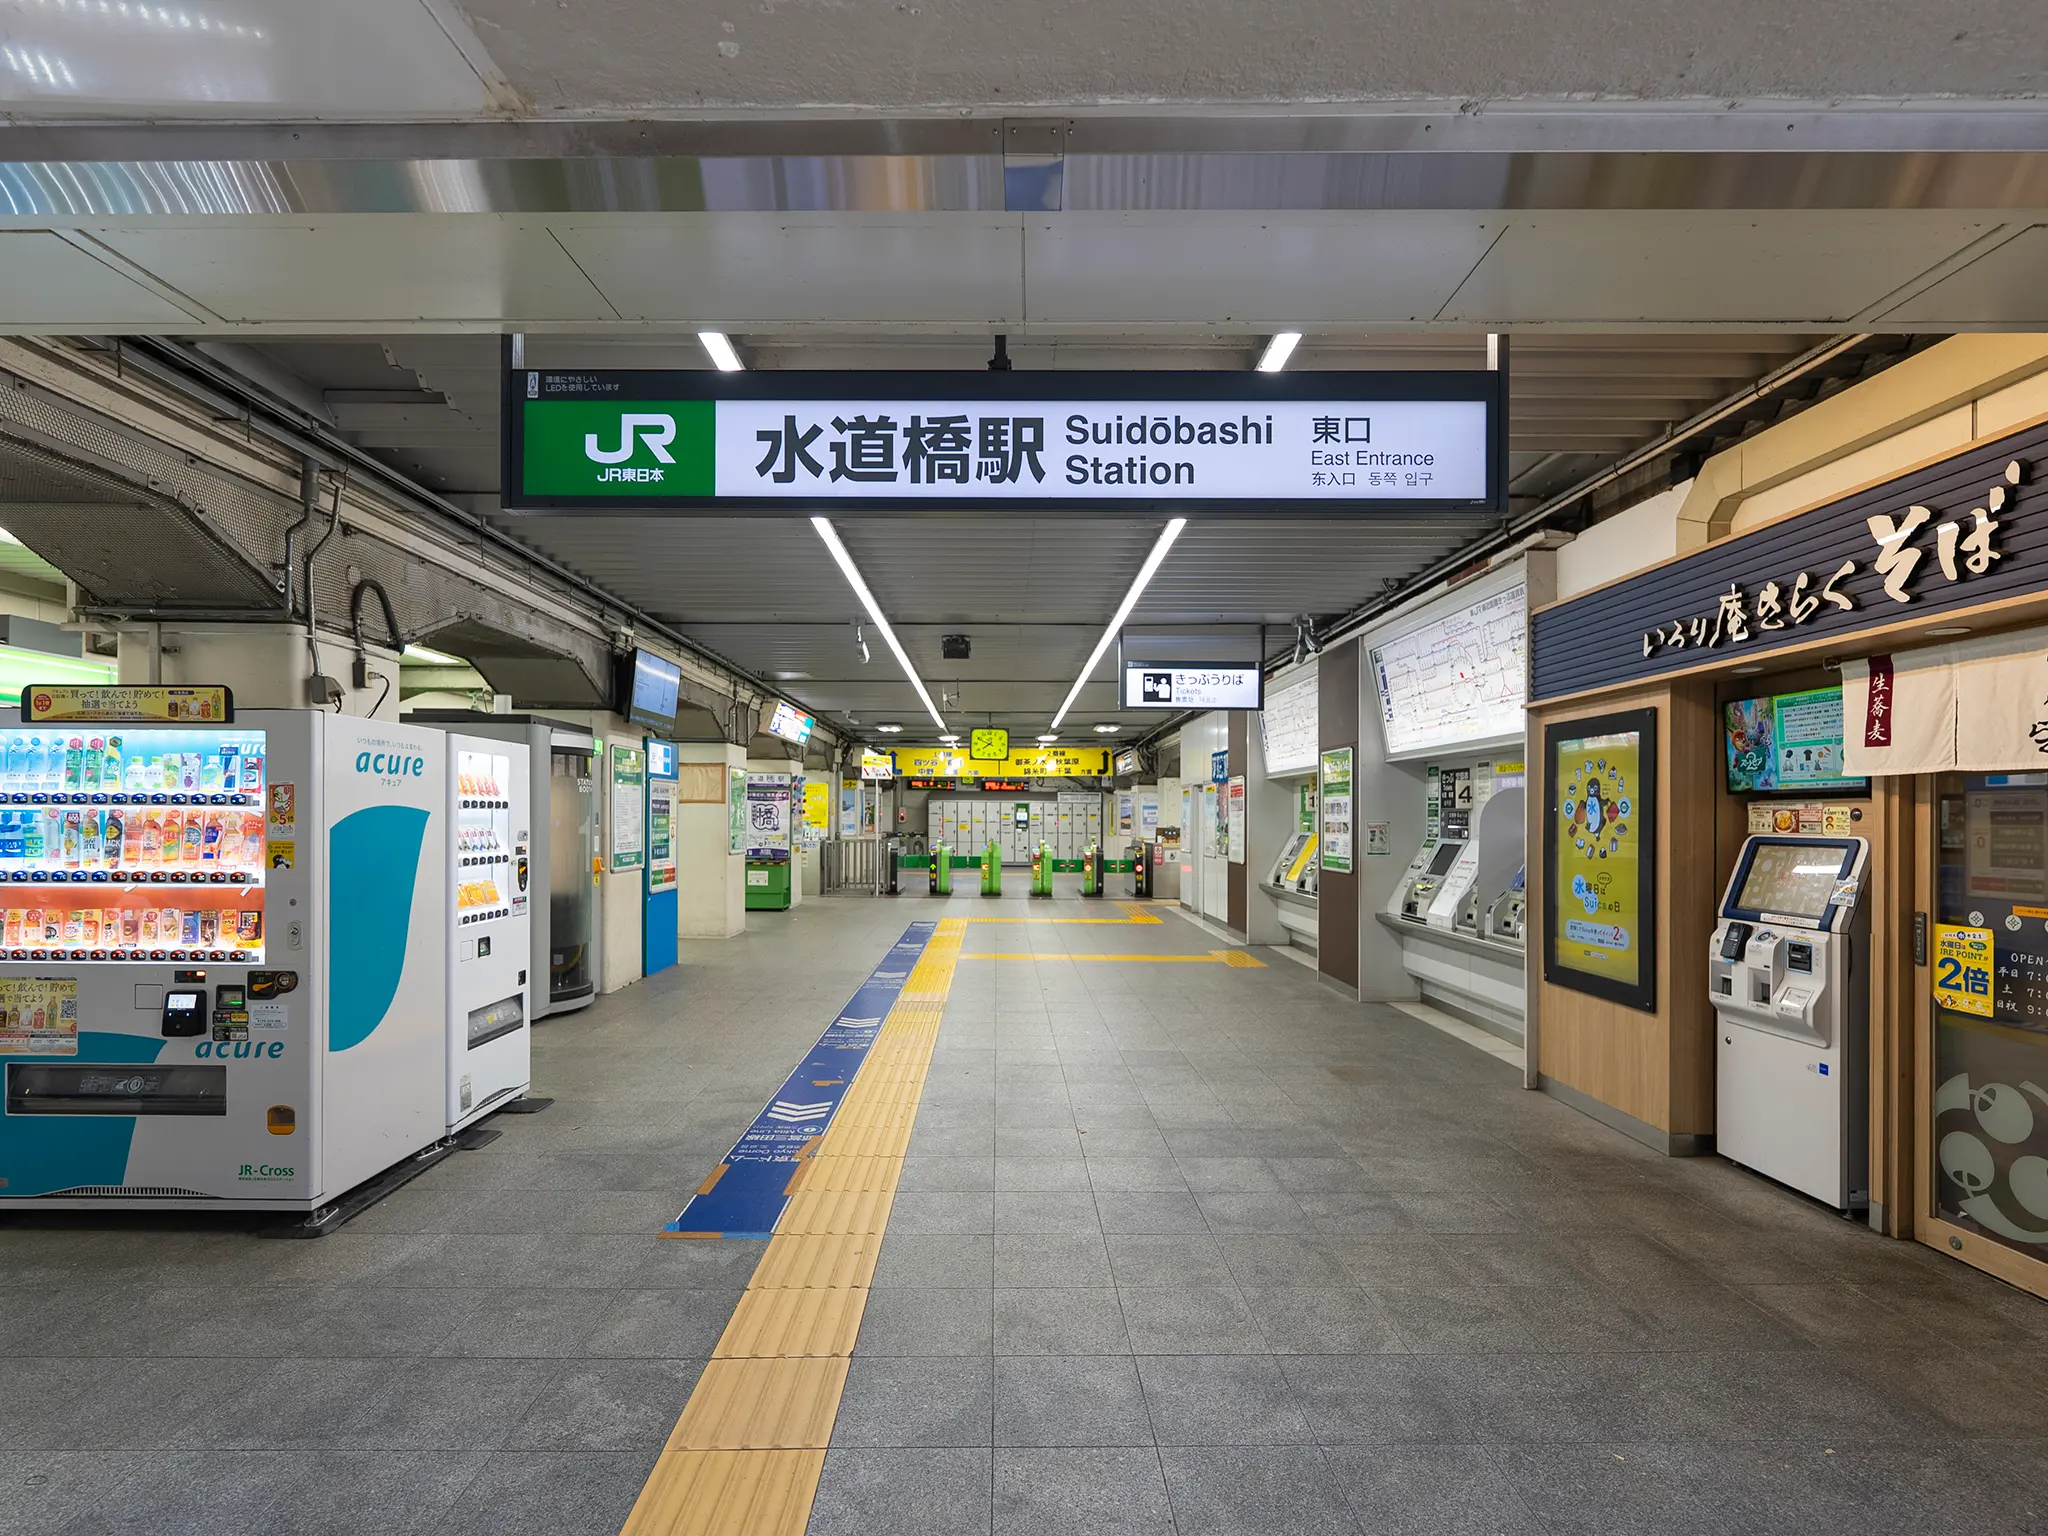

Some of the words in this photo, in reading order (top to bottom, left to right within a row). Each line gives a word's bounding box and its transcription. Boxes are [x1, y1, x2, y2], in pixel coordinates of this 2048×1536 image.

[545, 375, 598, 384] 環境にやさしい
[545, 384, 620, 392] LEDを使用しています
[1065, 414, 1273, 446] Suidōbashi
[1312, 416, 1371, 445] 東口
[584, 413, 677, 465] JR
[755, 414, 1046, 485] 水道橋駅
[1311, 450, 1350, 466] East
[1356, 450, 1434, 467] Entrance
[596, 467, 665, 483] JR東日本
[1065, 454, 1195, 486] Station
[1311, 471, 1356, 487] 东入口
[1367, 471, 1397, 487] 동쪽
[1404, 471, 1434, 487] 입구
[1643, 559, 1856, 658] いろり庵きらく
[1866, 459, 2022, 603] そば
[1175, 673, 1245, 686] きっぷうりば
[1175, 687, 1202, 695] Tickets
[80, 699, 138, 709] 抽選で当てよう
[1866, 672, 1890, 742] 生蕎麦
[355, 751, 424, 777] acure
[1015, 758, 1080, 766] 御茶ノ水秋葉原
[380, 778, 402, 787] アキュア
[1458, 785, 1473, 803] 4
[1588, 800, 1597, 815] 水
[757, 807, 777, 827] 橋
[1574, 879, 1606, 895] 水曜日は
[1584, 896, 1620, 913] Suicaの日
[1940, 940, 1966, 950] 水曜日は
[1940, 947, 1954, 956] JRE
[1956, 950, 1983, 961] POINT
[1938, 957, 1990, 996] 2倍
[1998, 966, 2019, 978] 平日
[2002, 984, 2013, 994] 土
[1997, 1000, 2019, 1012] 日祝
[195, 1041, 285, 1059] acure
[238, 1164, 295, 1176] JR-Cross
